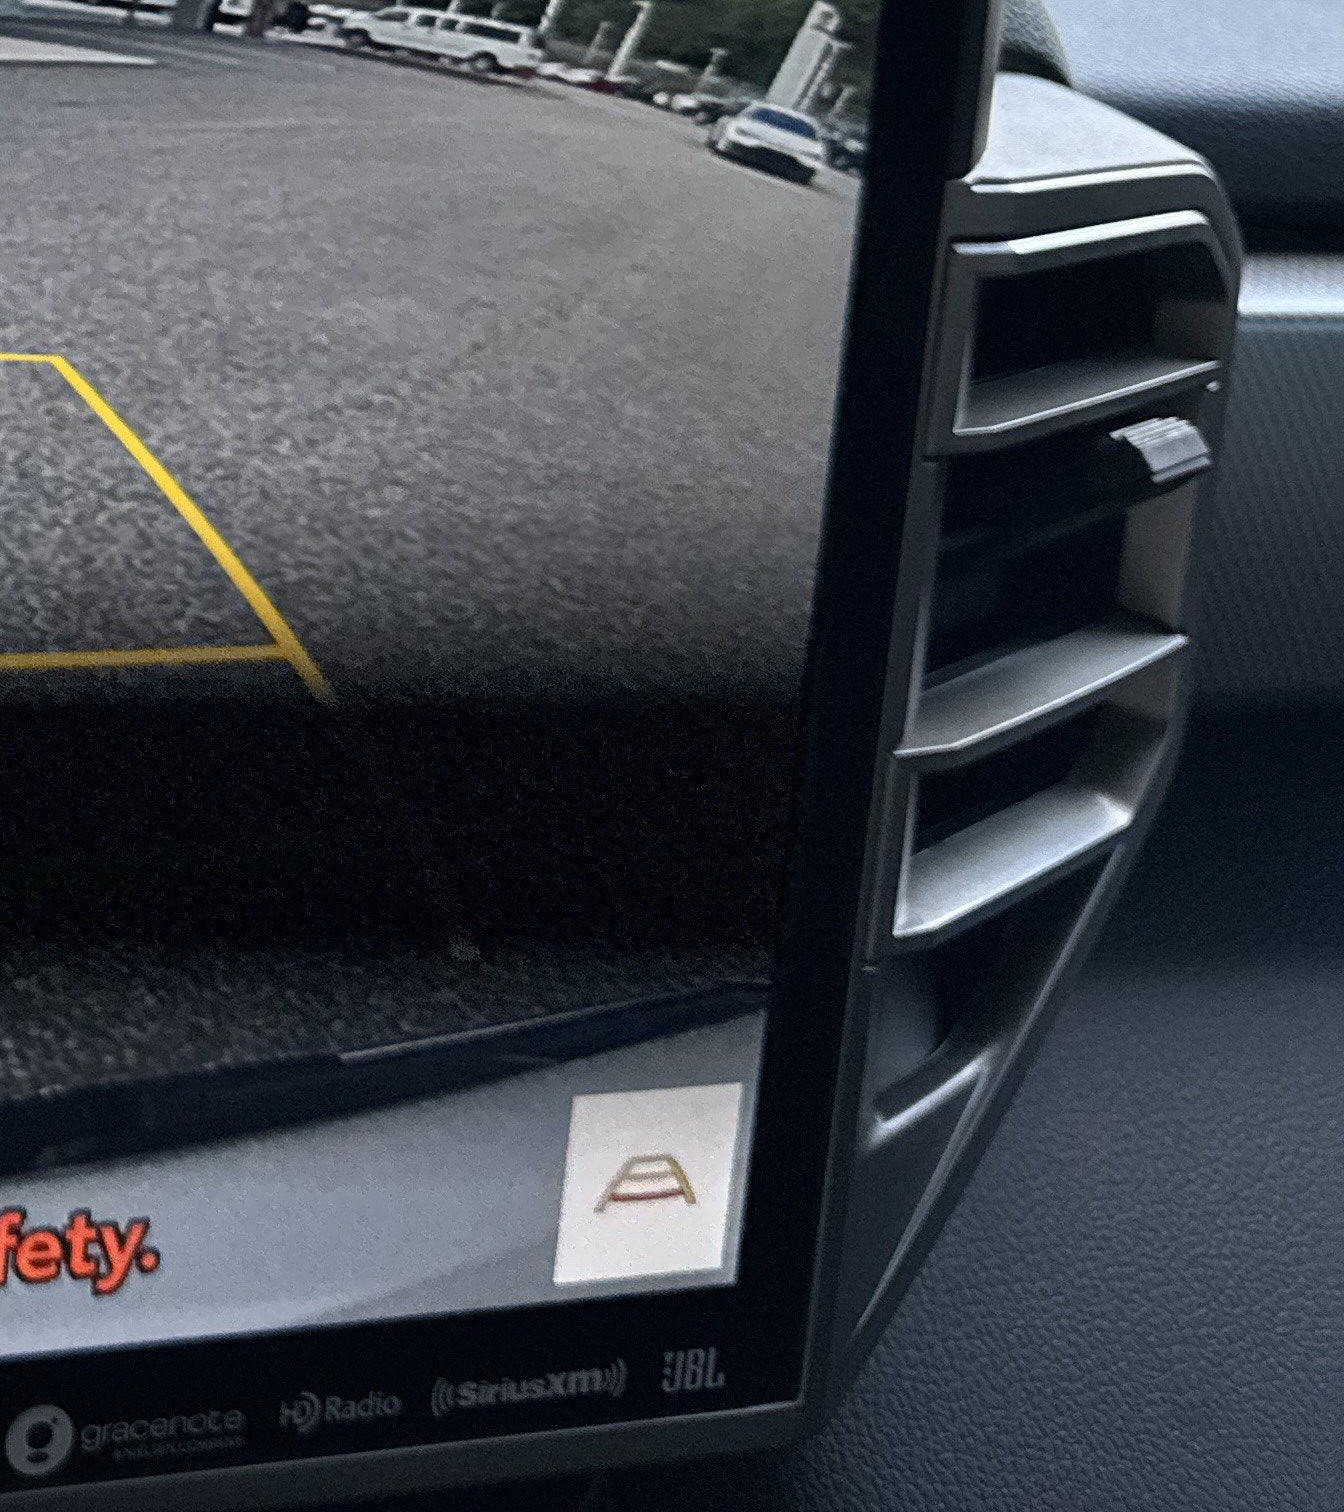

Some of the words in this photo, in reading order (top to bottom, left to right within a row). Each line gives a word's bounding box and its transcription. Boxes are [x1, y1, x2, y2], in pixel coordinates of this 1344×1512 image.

[661, 1345, 726, 1393] JBL
[324, 1390, 403, 1423] Radio
[81, 1409, 246, 1452] gracenote
